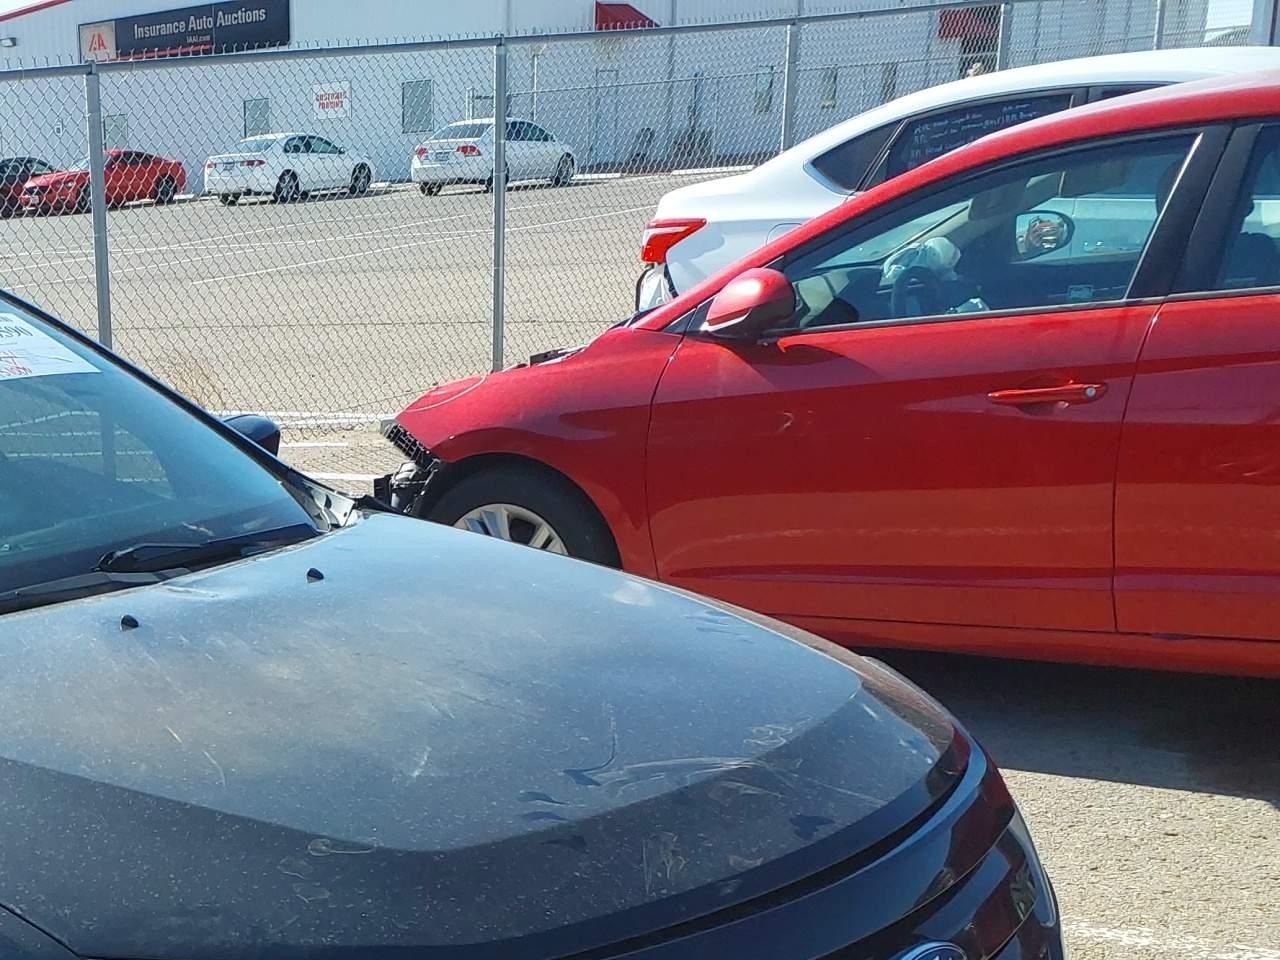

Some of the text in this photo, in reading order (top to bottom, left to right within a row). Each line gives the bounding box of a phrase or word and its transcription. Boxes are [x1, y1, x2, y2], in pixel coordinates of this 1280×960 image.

[134, 7, 267, 39] Insurance Auto Auctions
